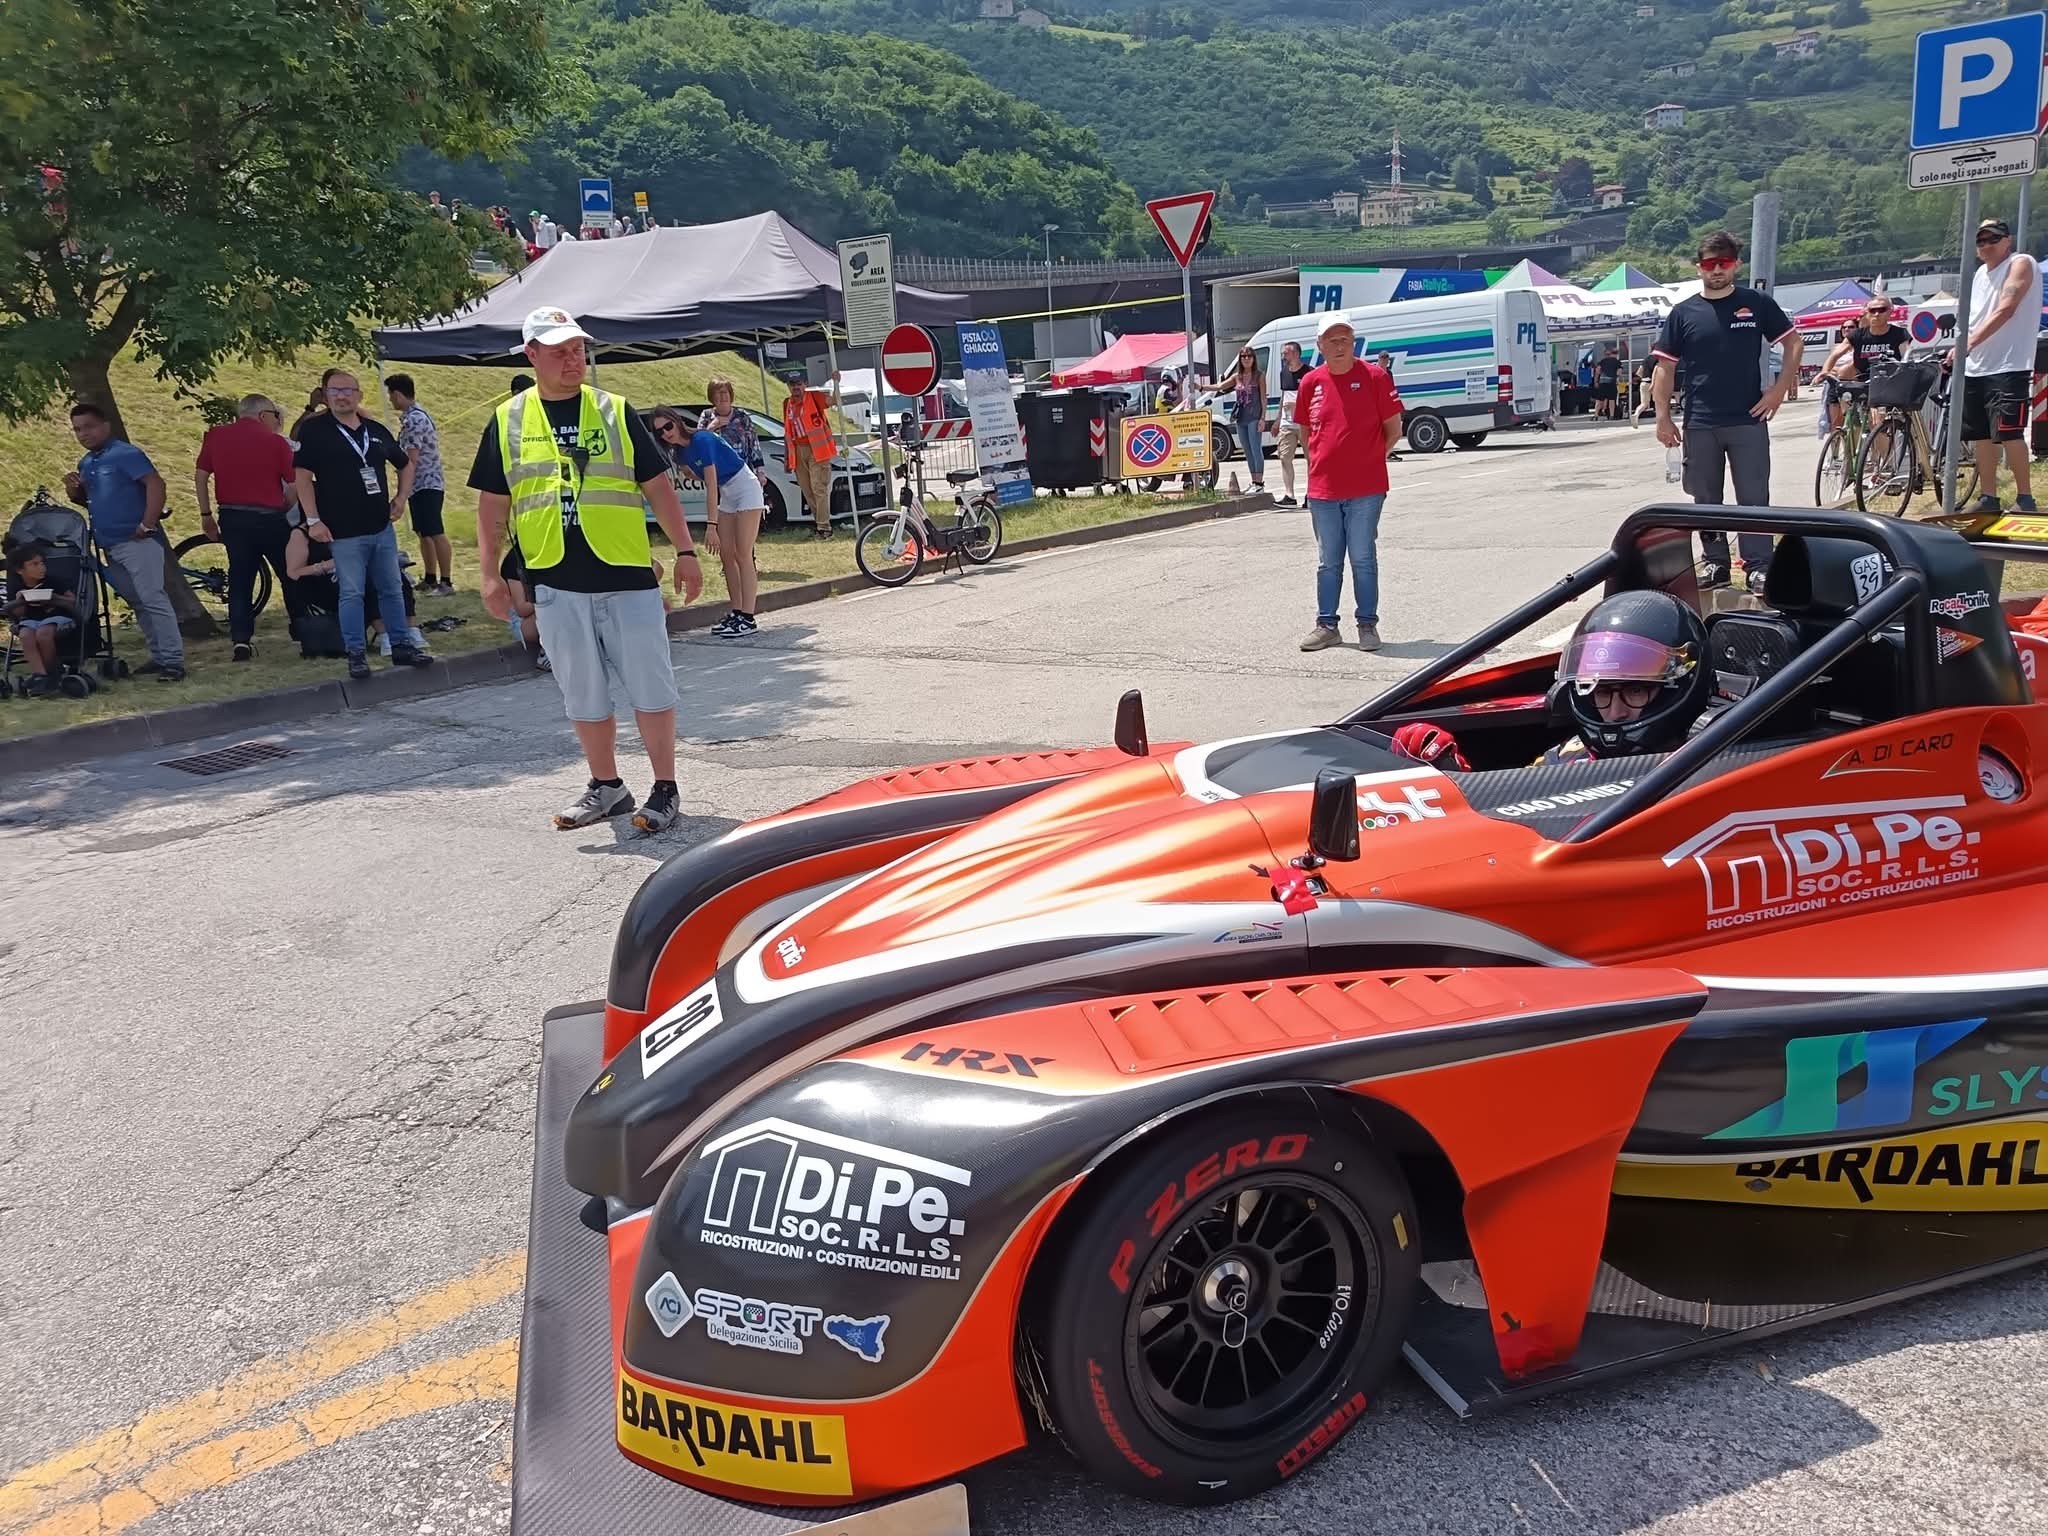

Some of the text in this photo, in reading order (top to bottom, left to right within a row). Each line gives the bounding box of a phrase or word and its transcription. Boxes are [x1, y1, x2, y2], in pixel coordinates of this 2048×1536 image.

[1939, 37, 2014, 130] P
[1919, 159, 2028, 183] solo negli spazi segnati
[870, 266, 885, 276] AREA
[1407, 280, 1423, 291] FABIA
[961, 332, 982, 343] PISTA
[963, 342, 999, 354] GHIACCIO
[1852, 556, 1879, 575] GAS
[1858, 571, 1879, 599] 39
[1848, 732, 1953, 767] A. DI CARO
[1496, 799, 1557, 817] CIAO
[1783, 812, 1981, 877] Di.Pe.
[1706, 867, 1980, 931] RICOSTRUZIONI COSTRUZIONI EDILI
[1796, 868, 1873, 898] SOC.
[645, 993, 715, 1059] 29
[900, 1041, 1057, 1079] HRX
[784, 1154, 966, 1237] Di.Pe.
[1145, 1133, 1311, 1237] ZERO
[779, 1214, 850, 1248] SOC.
[700, 1228, 960, 1281] RICOSTRUZIONI COSTRUZIONI EDILI
[659, 1297, 682, 1316] ACI
[696, 1292, 818, 1334] SPORT
[1319, 1284, 1352, 1349] EVO Corse
[710, 1323, 800, 1351] Delegazione Sicilia
[621, 1377, 833, 1468] BARDAHL
